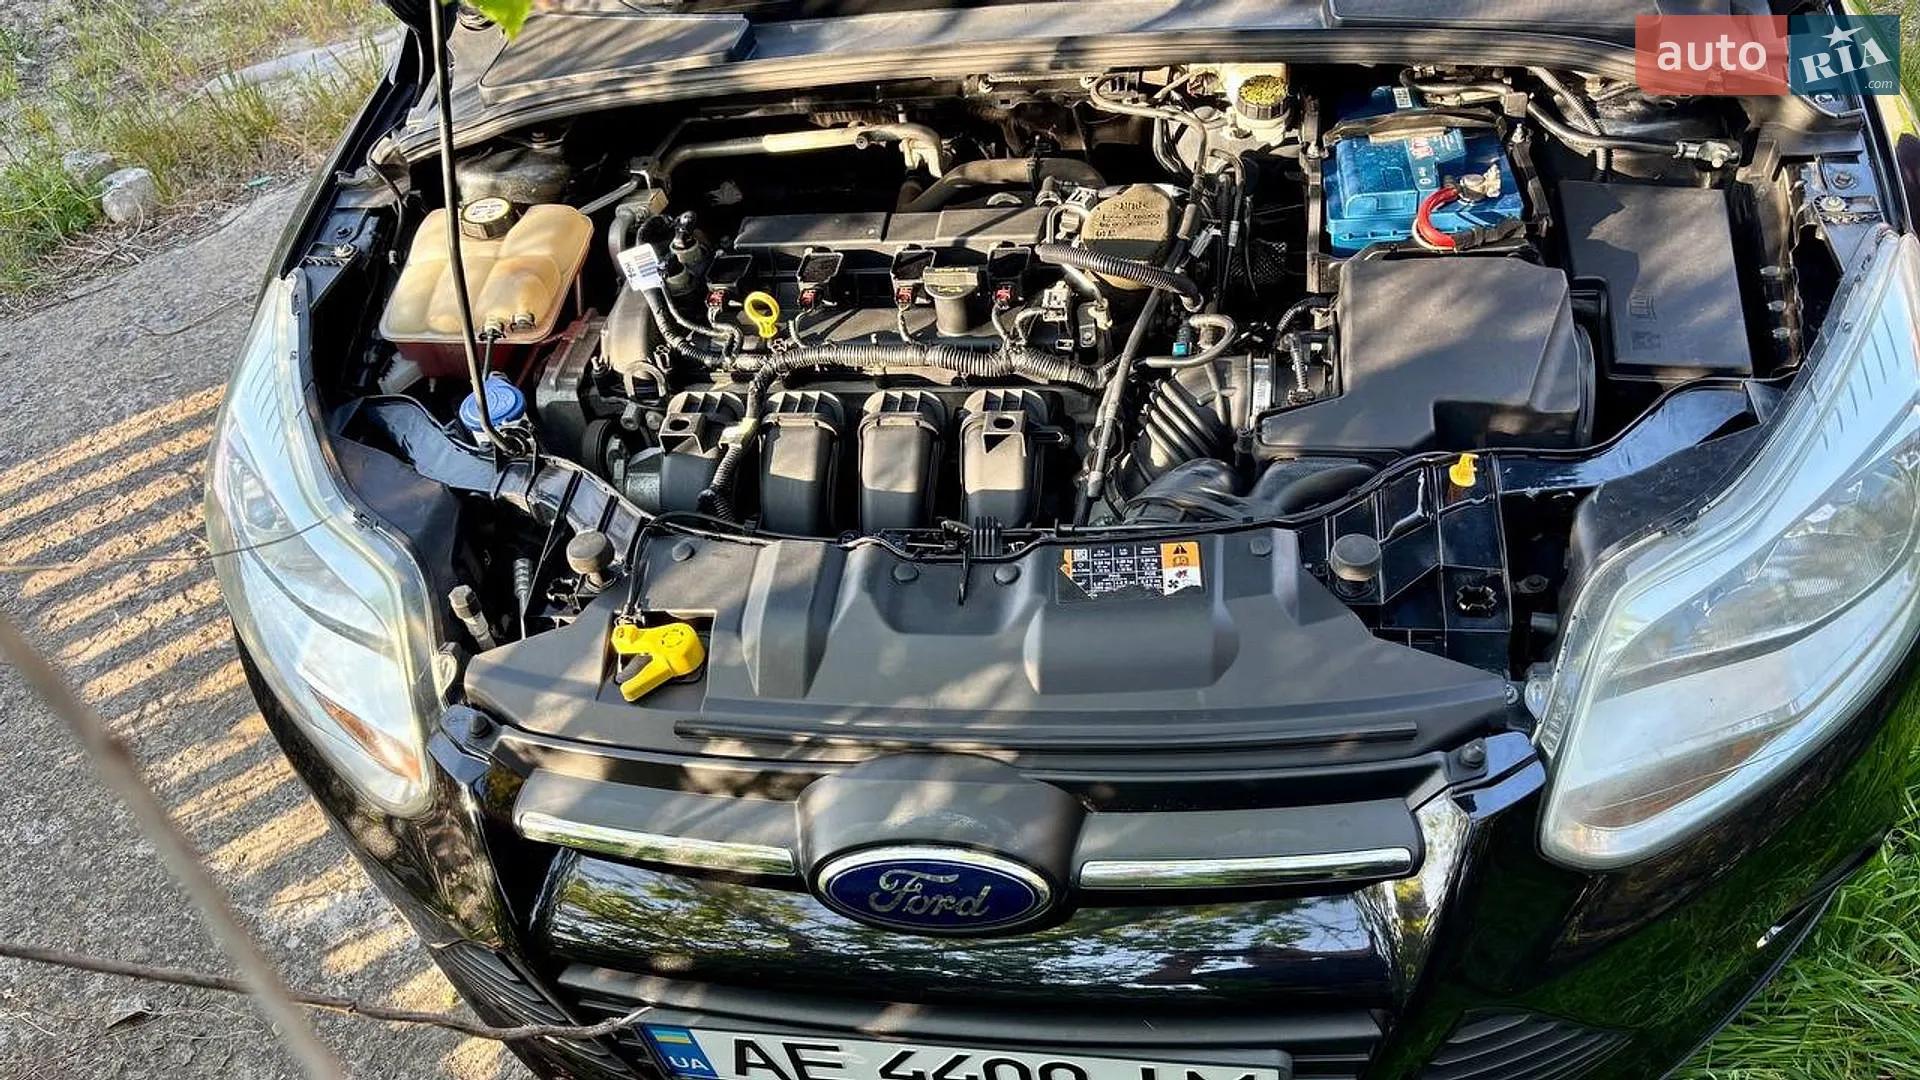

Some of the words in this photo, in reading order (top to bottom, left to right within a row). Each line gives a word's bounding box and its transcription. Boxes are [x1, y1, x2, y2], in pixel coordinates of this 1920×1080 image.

[868, 869, 991, 917] Ford
[668, 1055, 710, 1071] UA
[734, 1038, 845, 1080] AE
